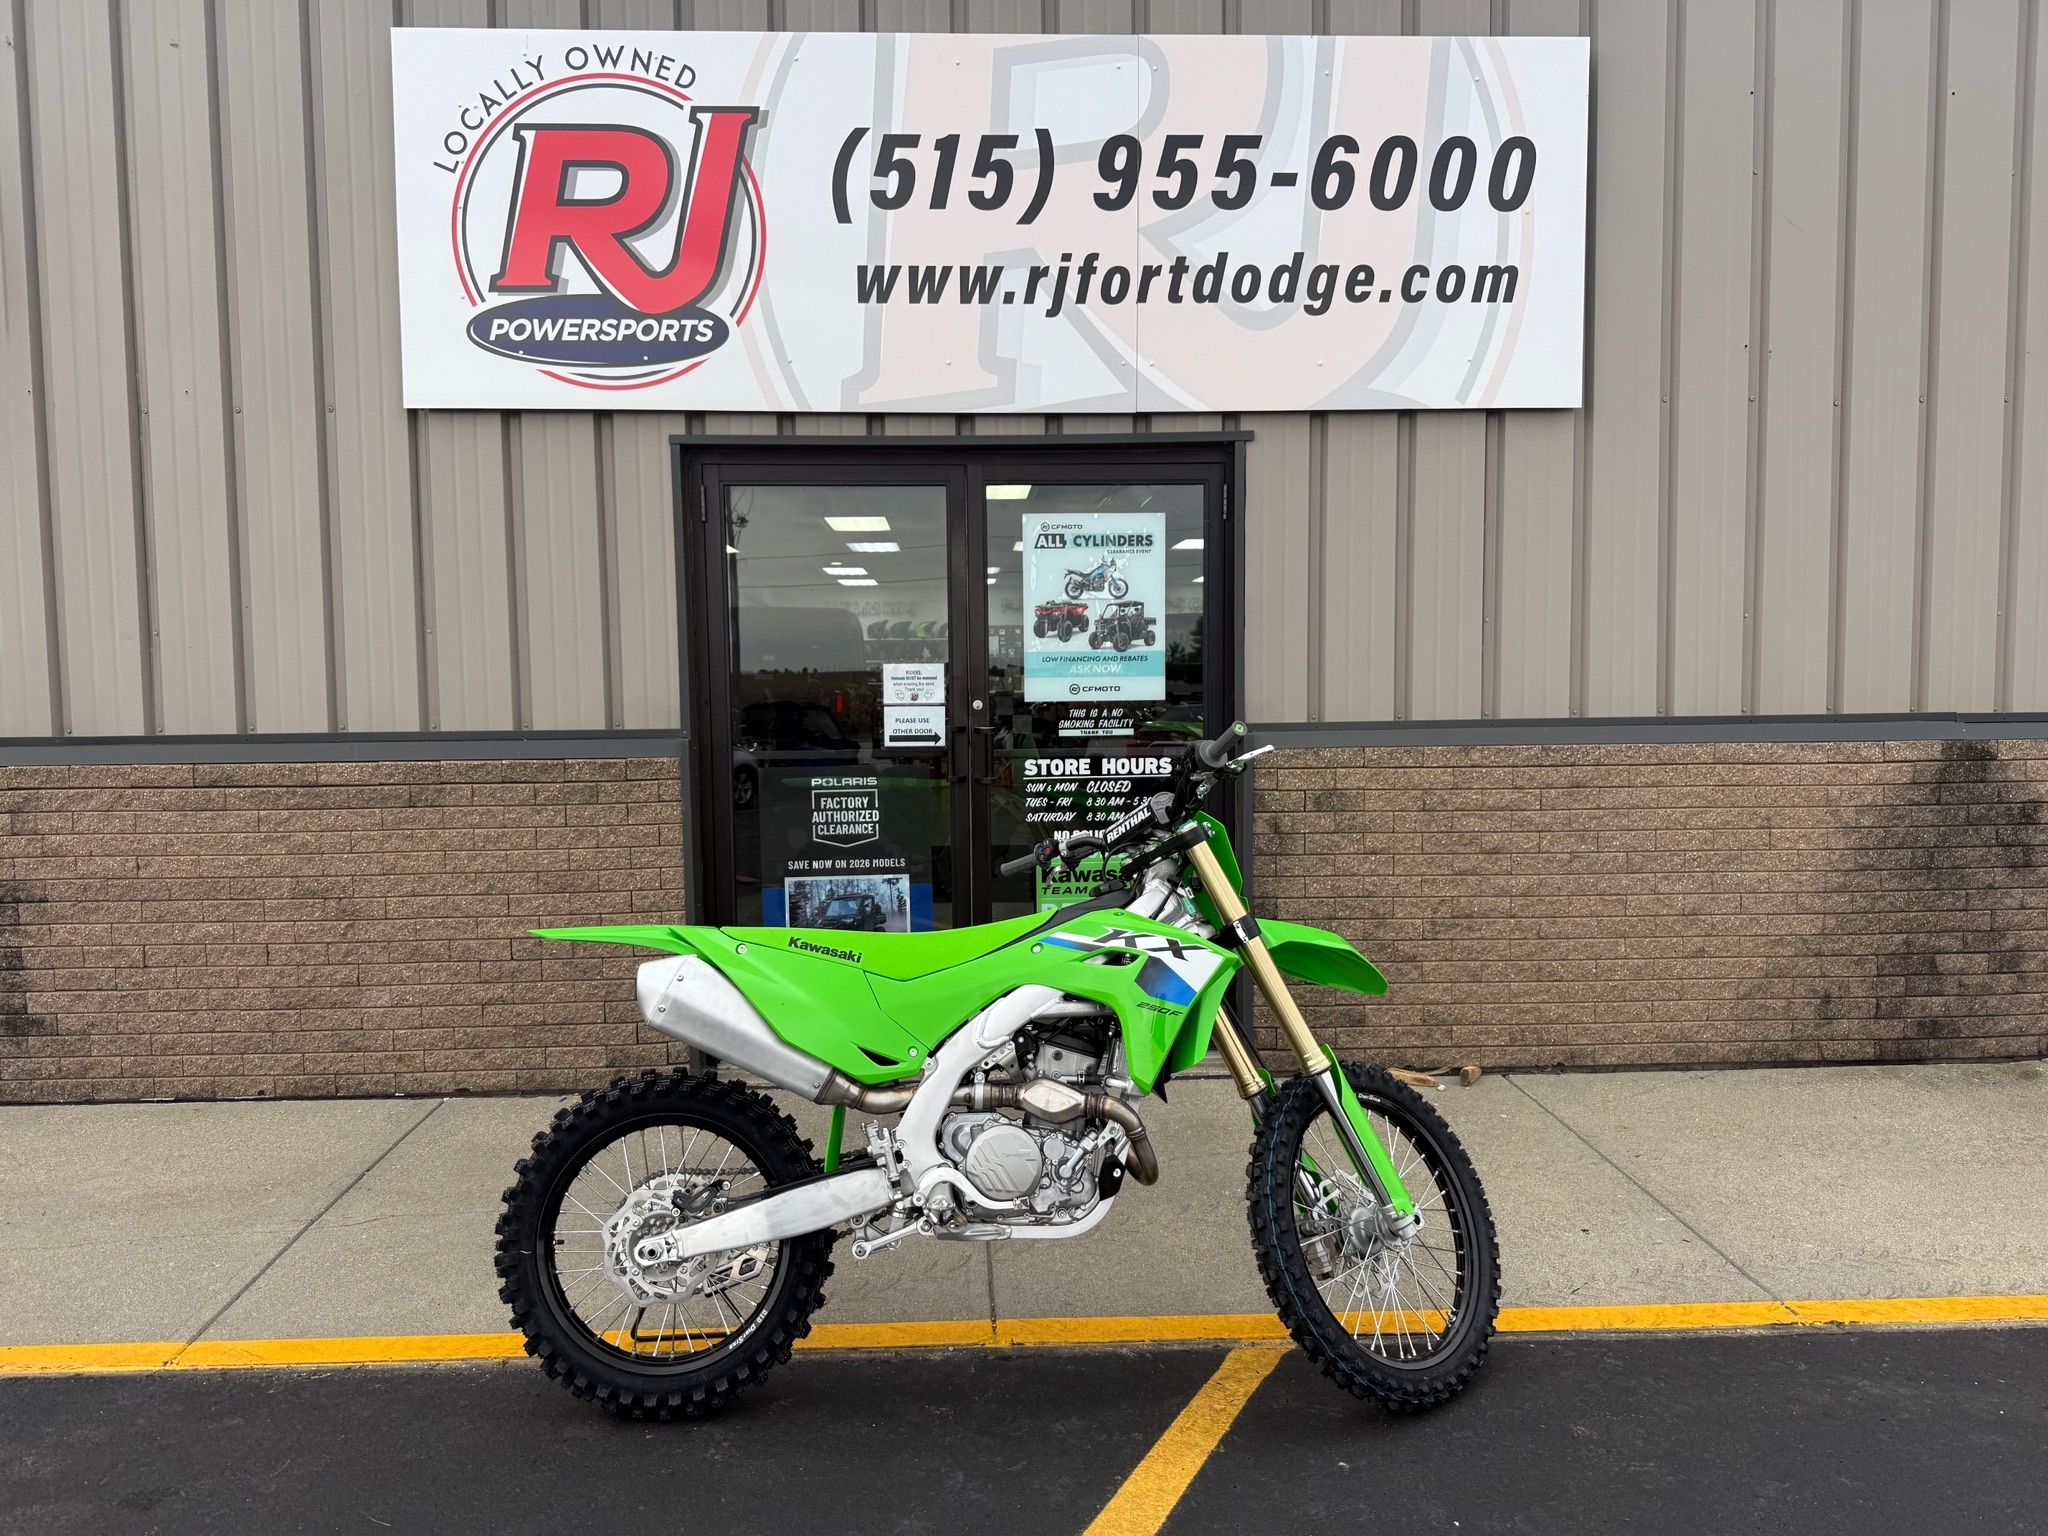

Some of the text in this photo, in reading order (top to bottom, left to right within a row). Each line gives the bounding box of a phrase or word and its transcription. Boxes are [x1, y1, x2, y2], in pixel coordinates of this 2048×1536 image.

[433, 44, 697, 174] LOCALLY OWNED
[831, 127, 1537, 225] (515) 955-6000
[488, 106, 760, 314] RJ
[856, 251, 1518, 318] www.rjfortdodge.com
[489, 318, 714, 342] POWERSPORTS
[1037, 533, 1153, 548] ALL CYLINDERS
[1069, 665, 1122, 674] ASK NOW
[1069, 708, 1124, 718] THIS IS A NO
[1058, 718, 1134, 728] SMOKING FACILITY
[1024, 757, 1172, 776] STORE HOURS
[811, 777, 878, 787] POLARIS
[1025, 782, 1045, 792] SUN
[1054, 782, 1079, 792] MON
[1086, 780, 1132, 793] CLOSED
[820, 797, 869, 809] FACTORY
[1025, 797, 1049, 807] TUES
[1057, 797, 1072, 807] FRI
[1107, 796, 1126, 806] AM
[812, 810, 880, 823] AUTHORIZED
[1026, 812, 1077, 822] SATURDAY
[817, 823, 874, 835] CLEARANCE
[1106, 806, 1152, 844] RENTHAL
[788, 858, 906, 870] SAVE NOW ON 2026 MODELS
[1041, 867, 1125, 883] Kawas
[1042, 886, 1088, 895] TEAM
[787, 936, 863, 963] Kawasaki
[1092, 928, 1208, 962] KX
[1136, 1001, 1183, 1016] 250F
